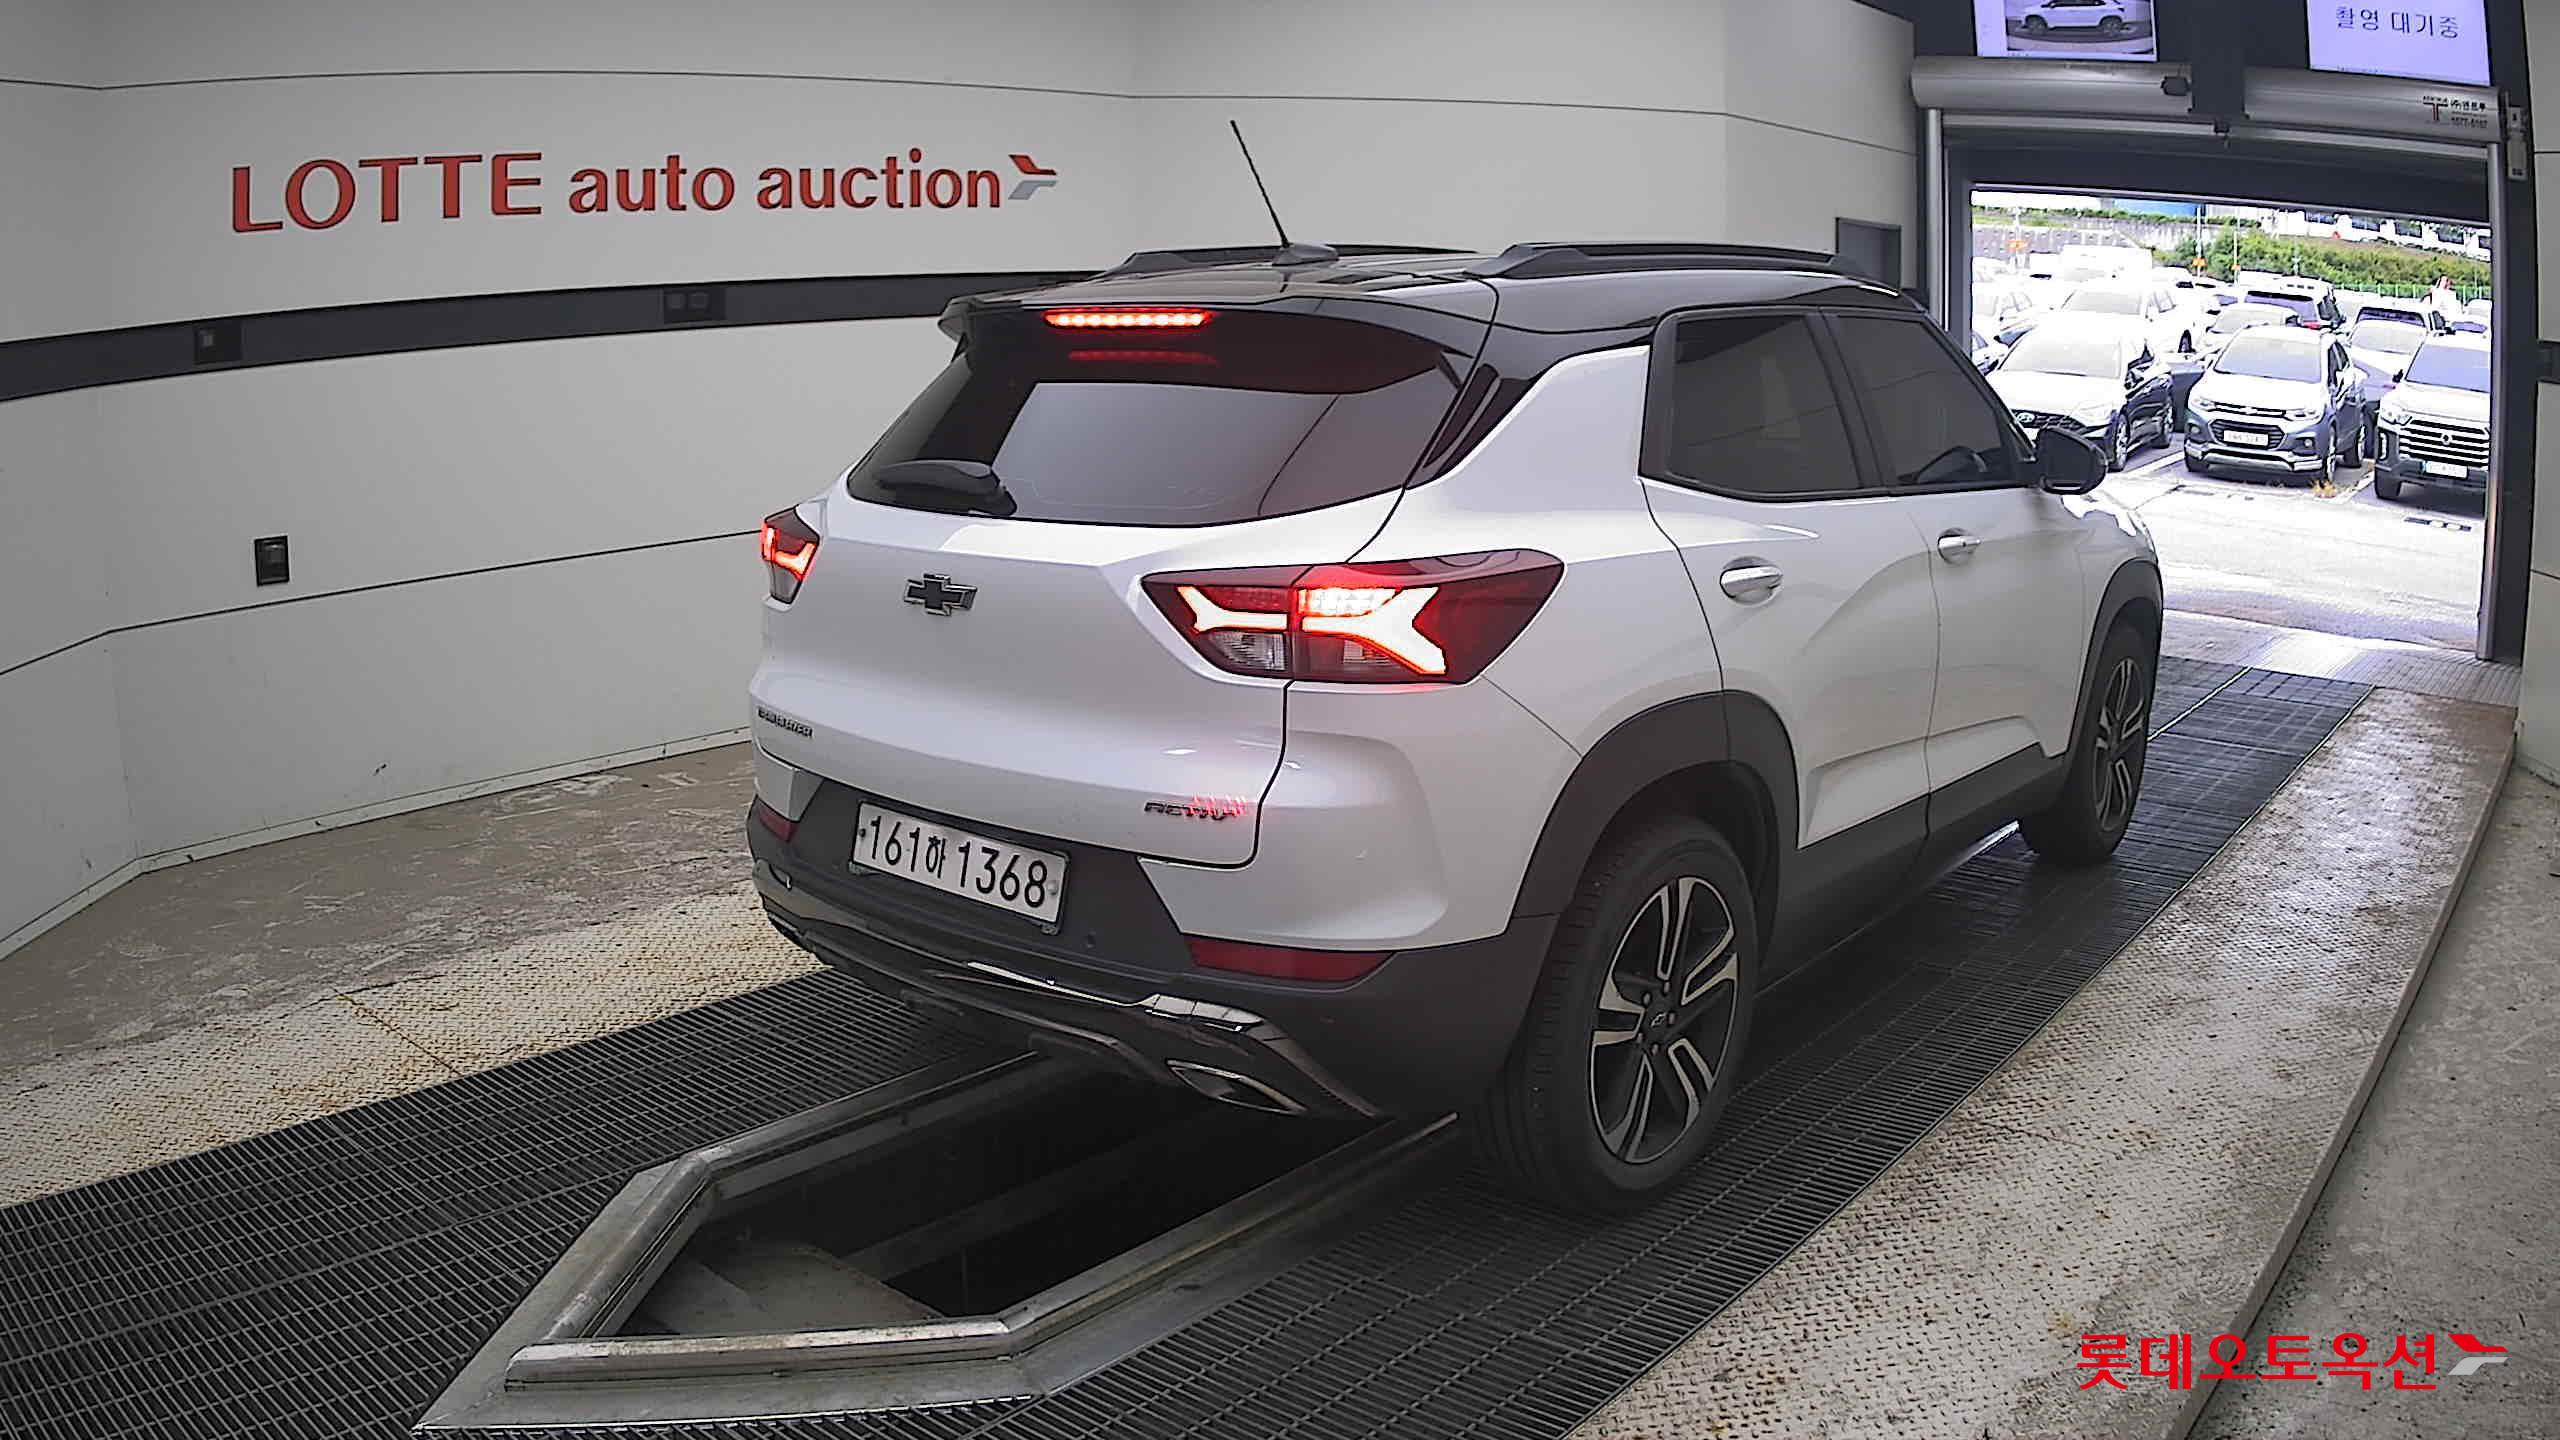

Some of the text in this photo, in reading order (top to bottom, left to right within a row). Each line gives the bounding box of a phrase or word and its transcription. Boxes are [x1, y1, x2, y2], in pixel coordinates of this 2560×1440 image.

[2336, 6, 2458, 39] 촬영 대기중
[231, 147, 1001, 233] LOTTE auto auction
